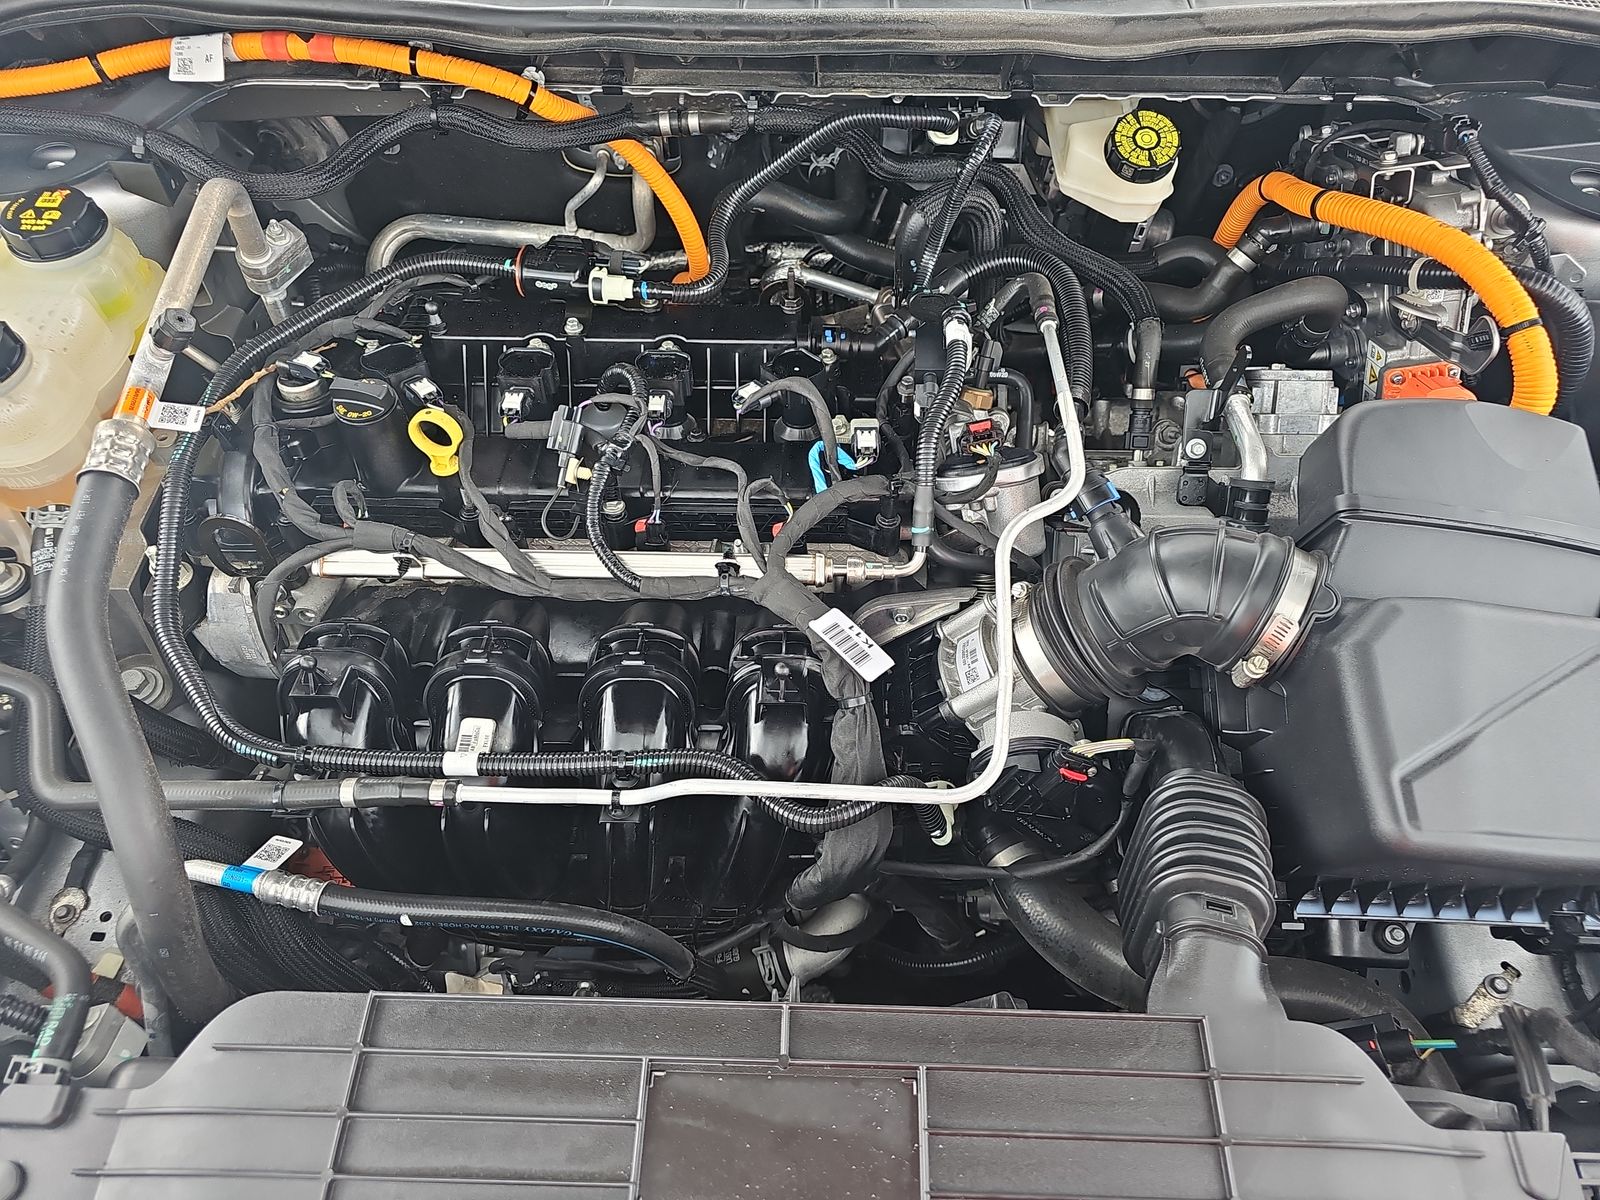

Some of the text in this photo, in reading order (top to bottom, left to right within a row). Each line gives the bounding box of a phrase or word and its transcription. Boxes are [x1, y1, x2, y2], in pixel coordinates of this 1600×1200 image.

[204, 54, 214, 63] AF
[336, 404, 348, 415] SAE
[848, 625, 874, 649] K11
[522, 926, 573, 936] GALAXY
